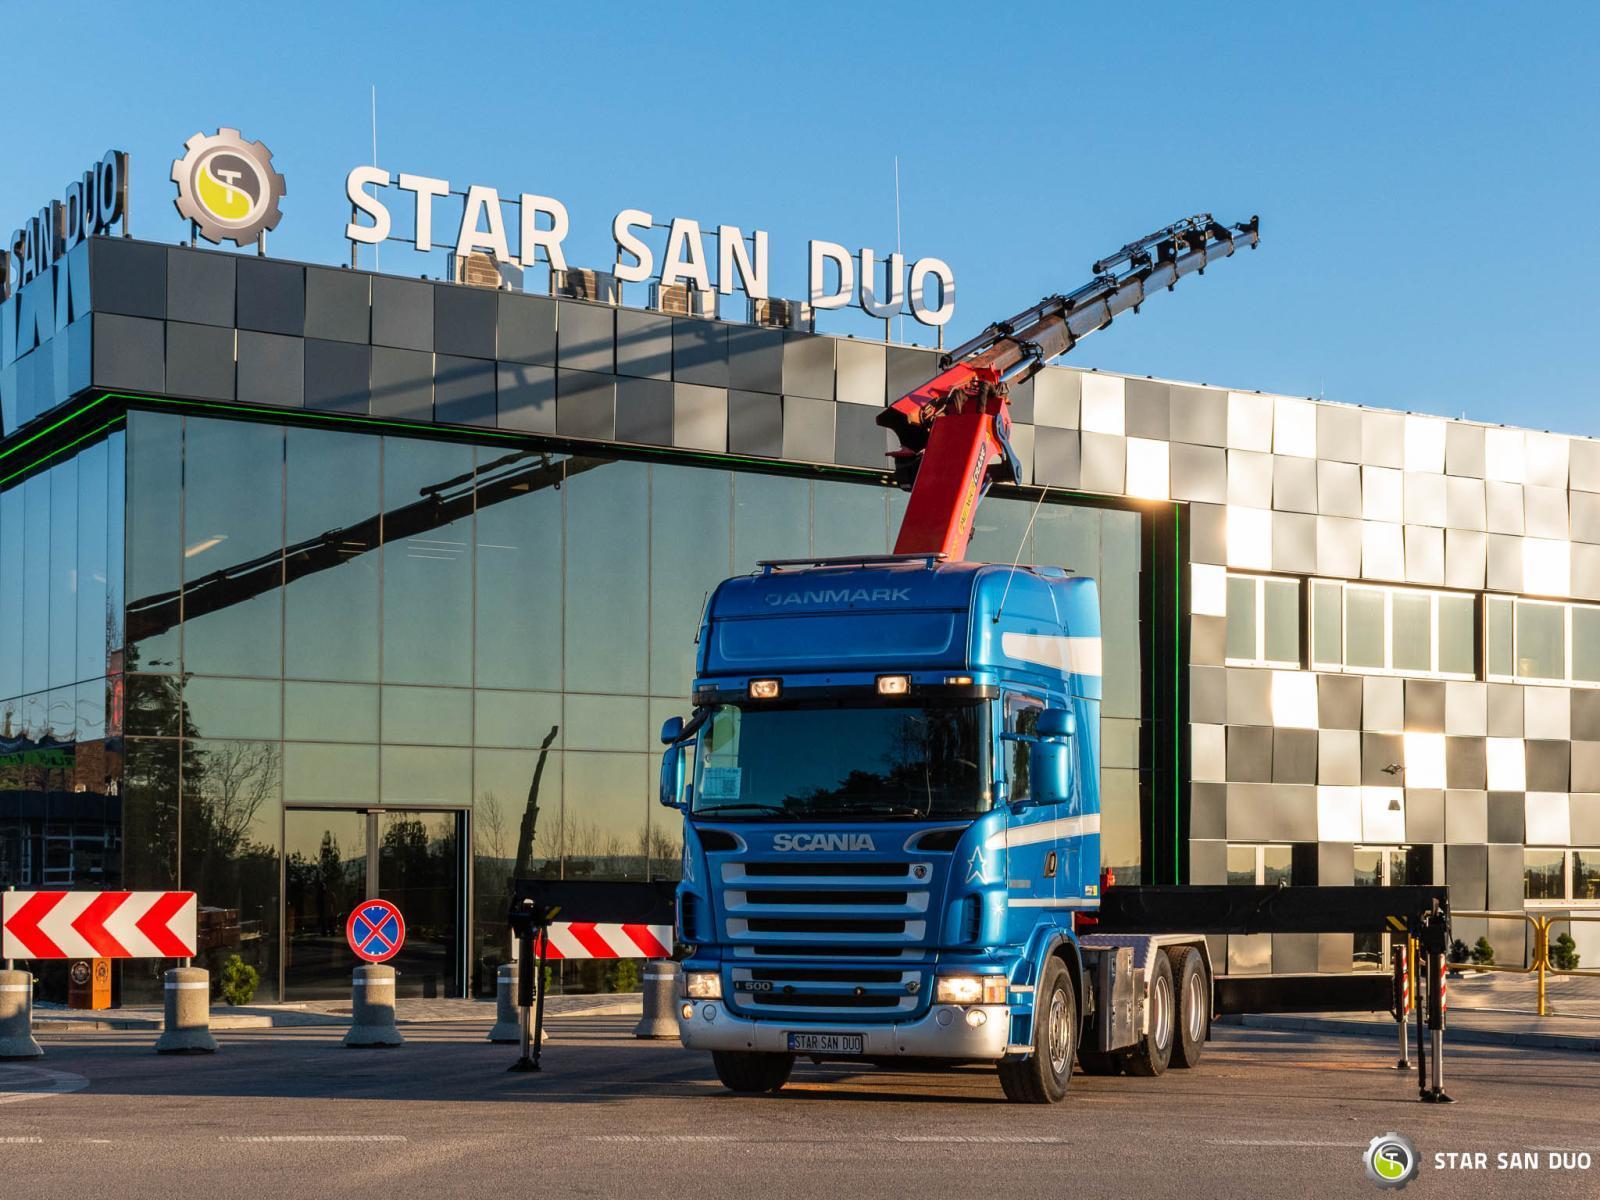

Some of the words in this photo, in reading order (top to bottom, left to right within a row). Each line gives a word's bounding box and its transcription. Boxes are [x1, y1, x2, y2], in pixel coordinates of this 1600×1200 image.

[66, 150, 123, 250] DUO
[346, 166, 569, 271] STAR
[612, 209, 769, 300] SAN
[809, 240, 956, 327] DUO
[773, 833, 876, 851] SCANIA
[745, 982, 770, 991] 500
[795, 1035, 818, 1049] STAR
[820, 1035, 839, 1050] SAN
[842, 1036, 861, 1051] DUO
